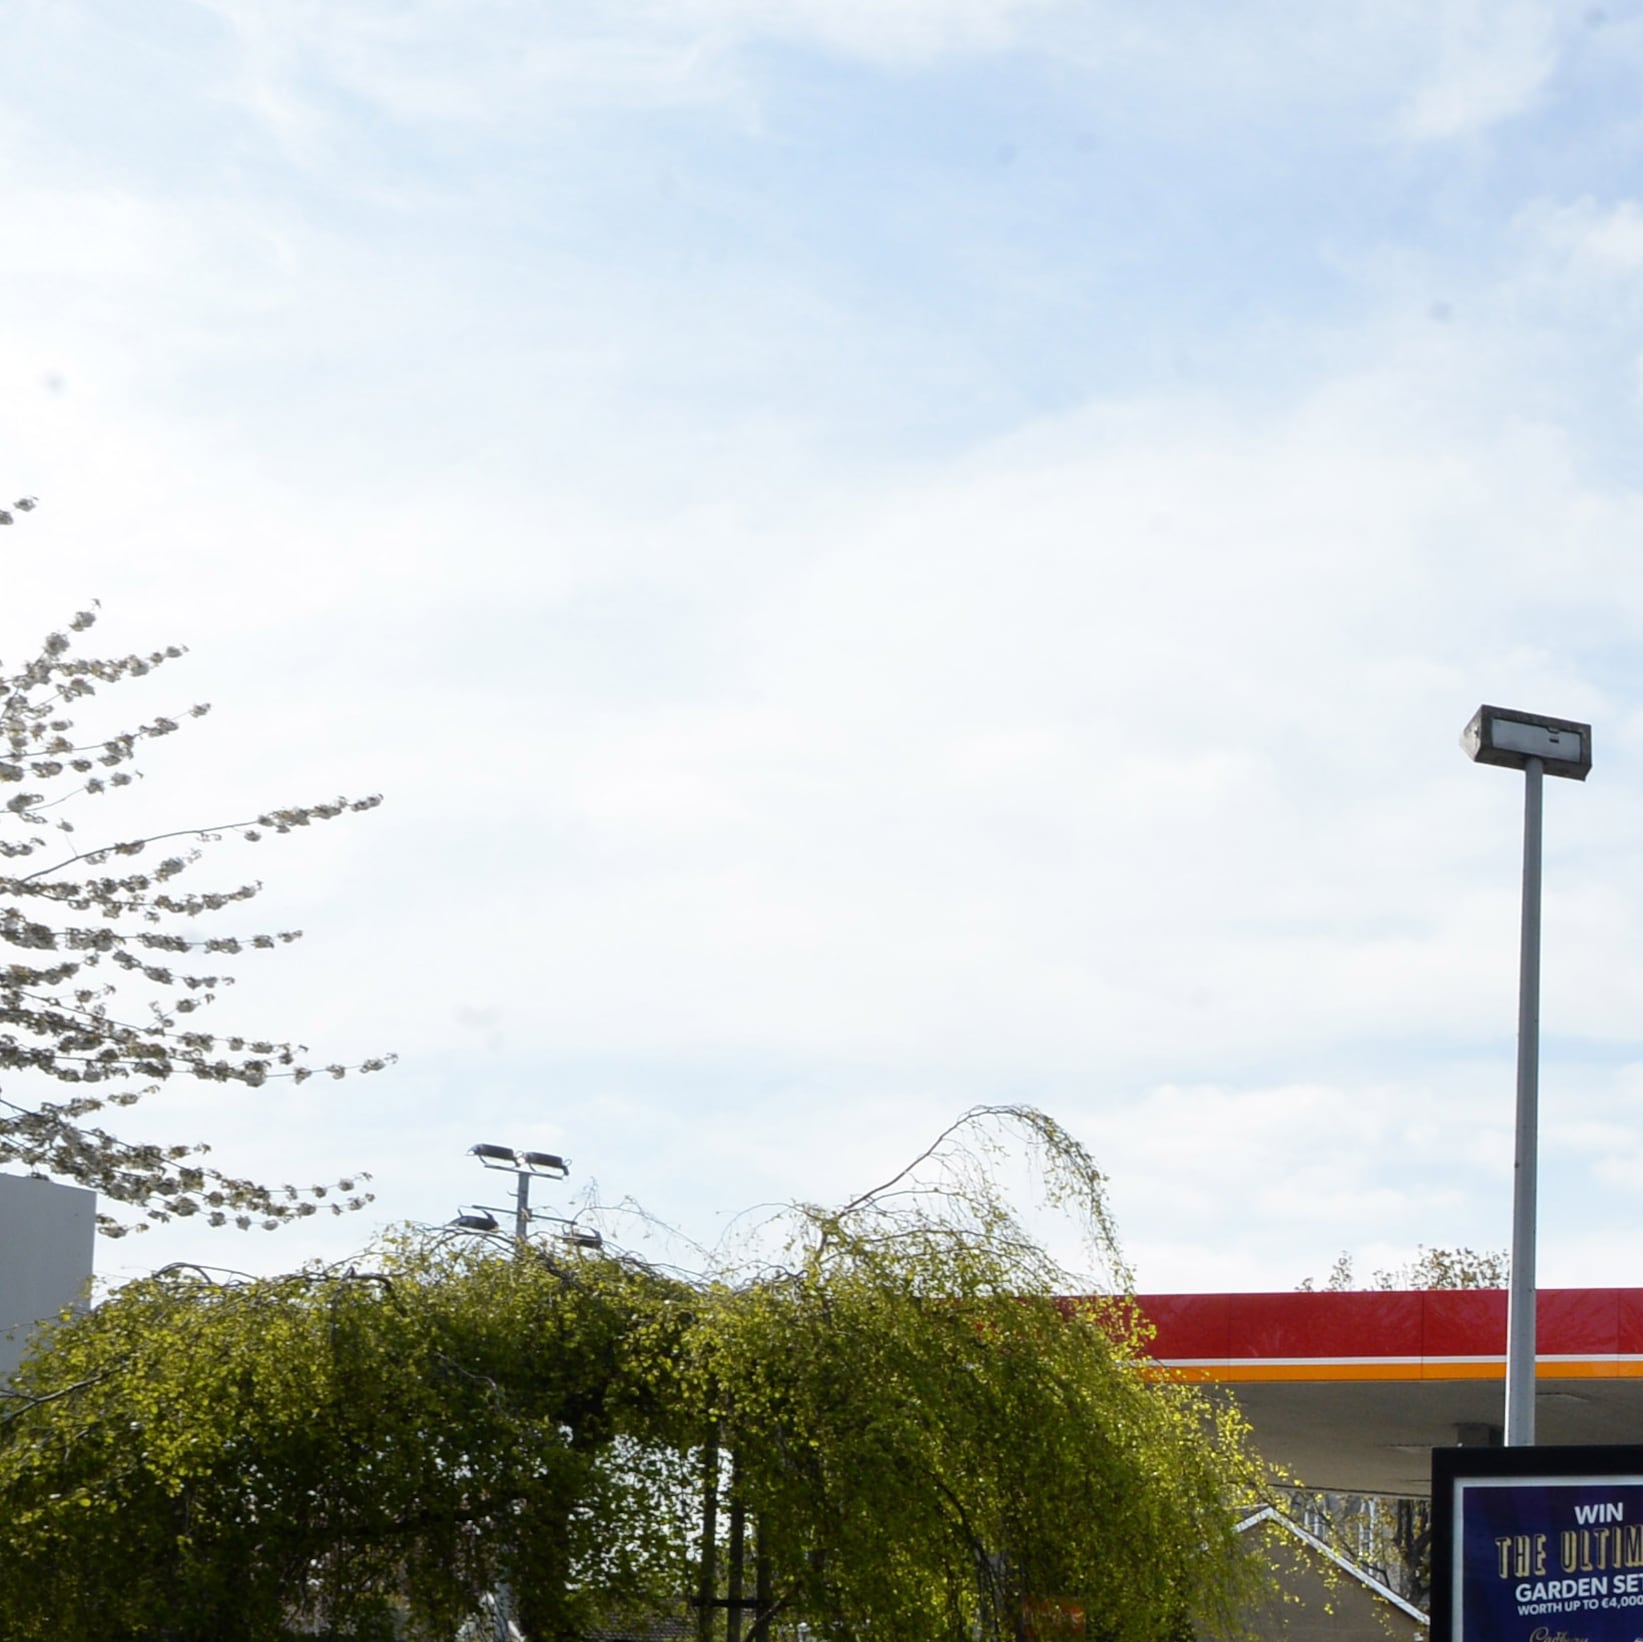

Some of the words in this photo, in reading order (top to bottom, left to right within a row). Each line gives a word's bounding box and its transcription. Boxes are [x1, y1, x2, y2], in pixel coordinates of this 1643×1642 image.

[1574, 1502, 1624, 1526] WIN
[1495, 1533, 1547, 1579] THE
[1515, 1576, 1608, 1602] GARDEN
[1517, 1600, 1562, 1616] WORTH
[1564, 1599, 1581, 1612] UP
[1583, 1598, 1599, 1610] TO
